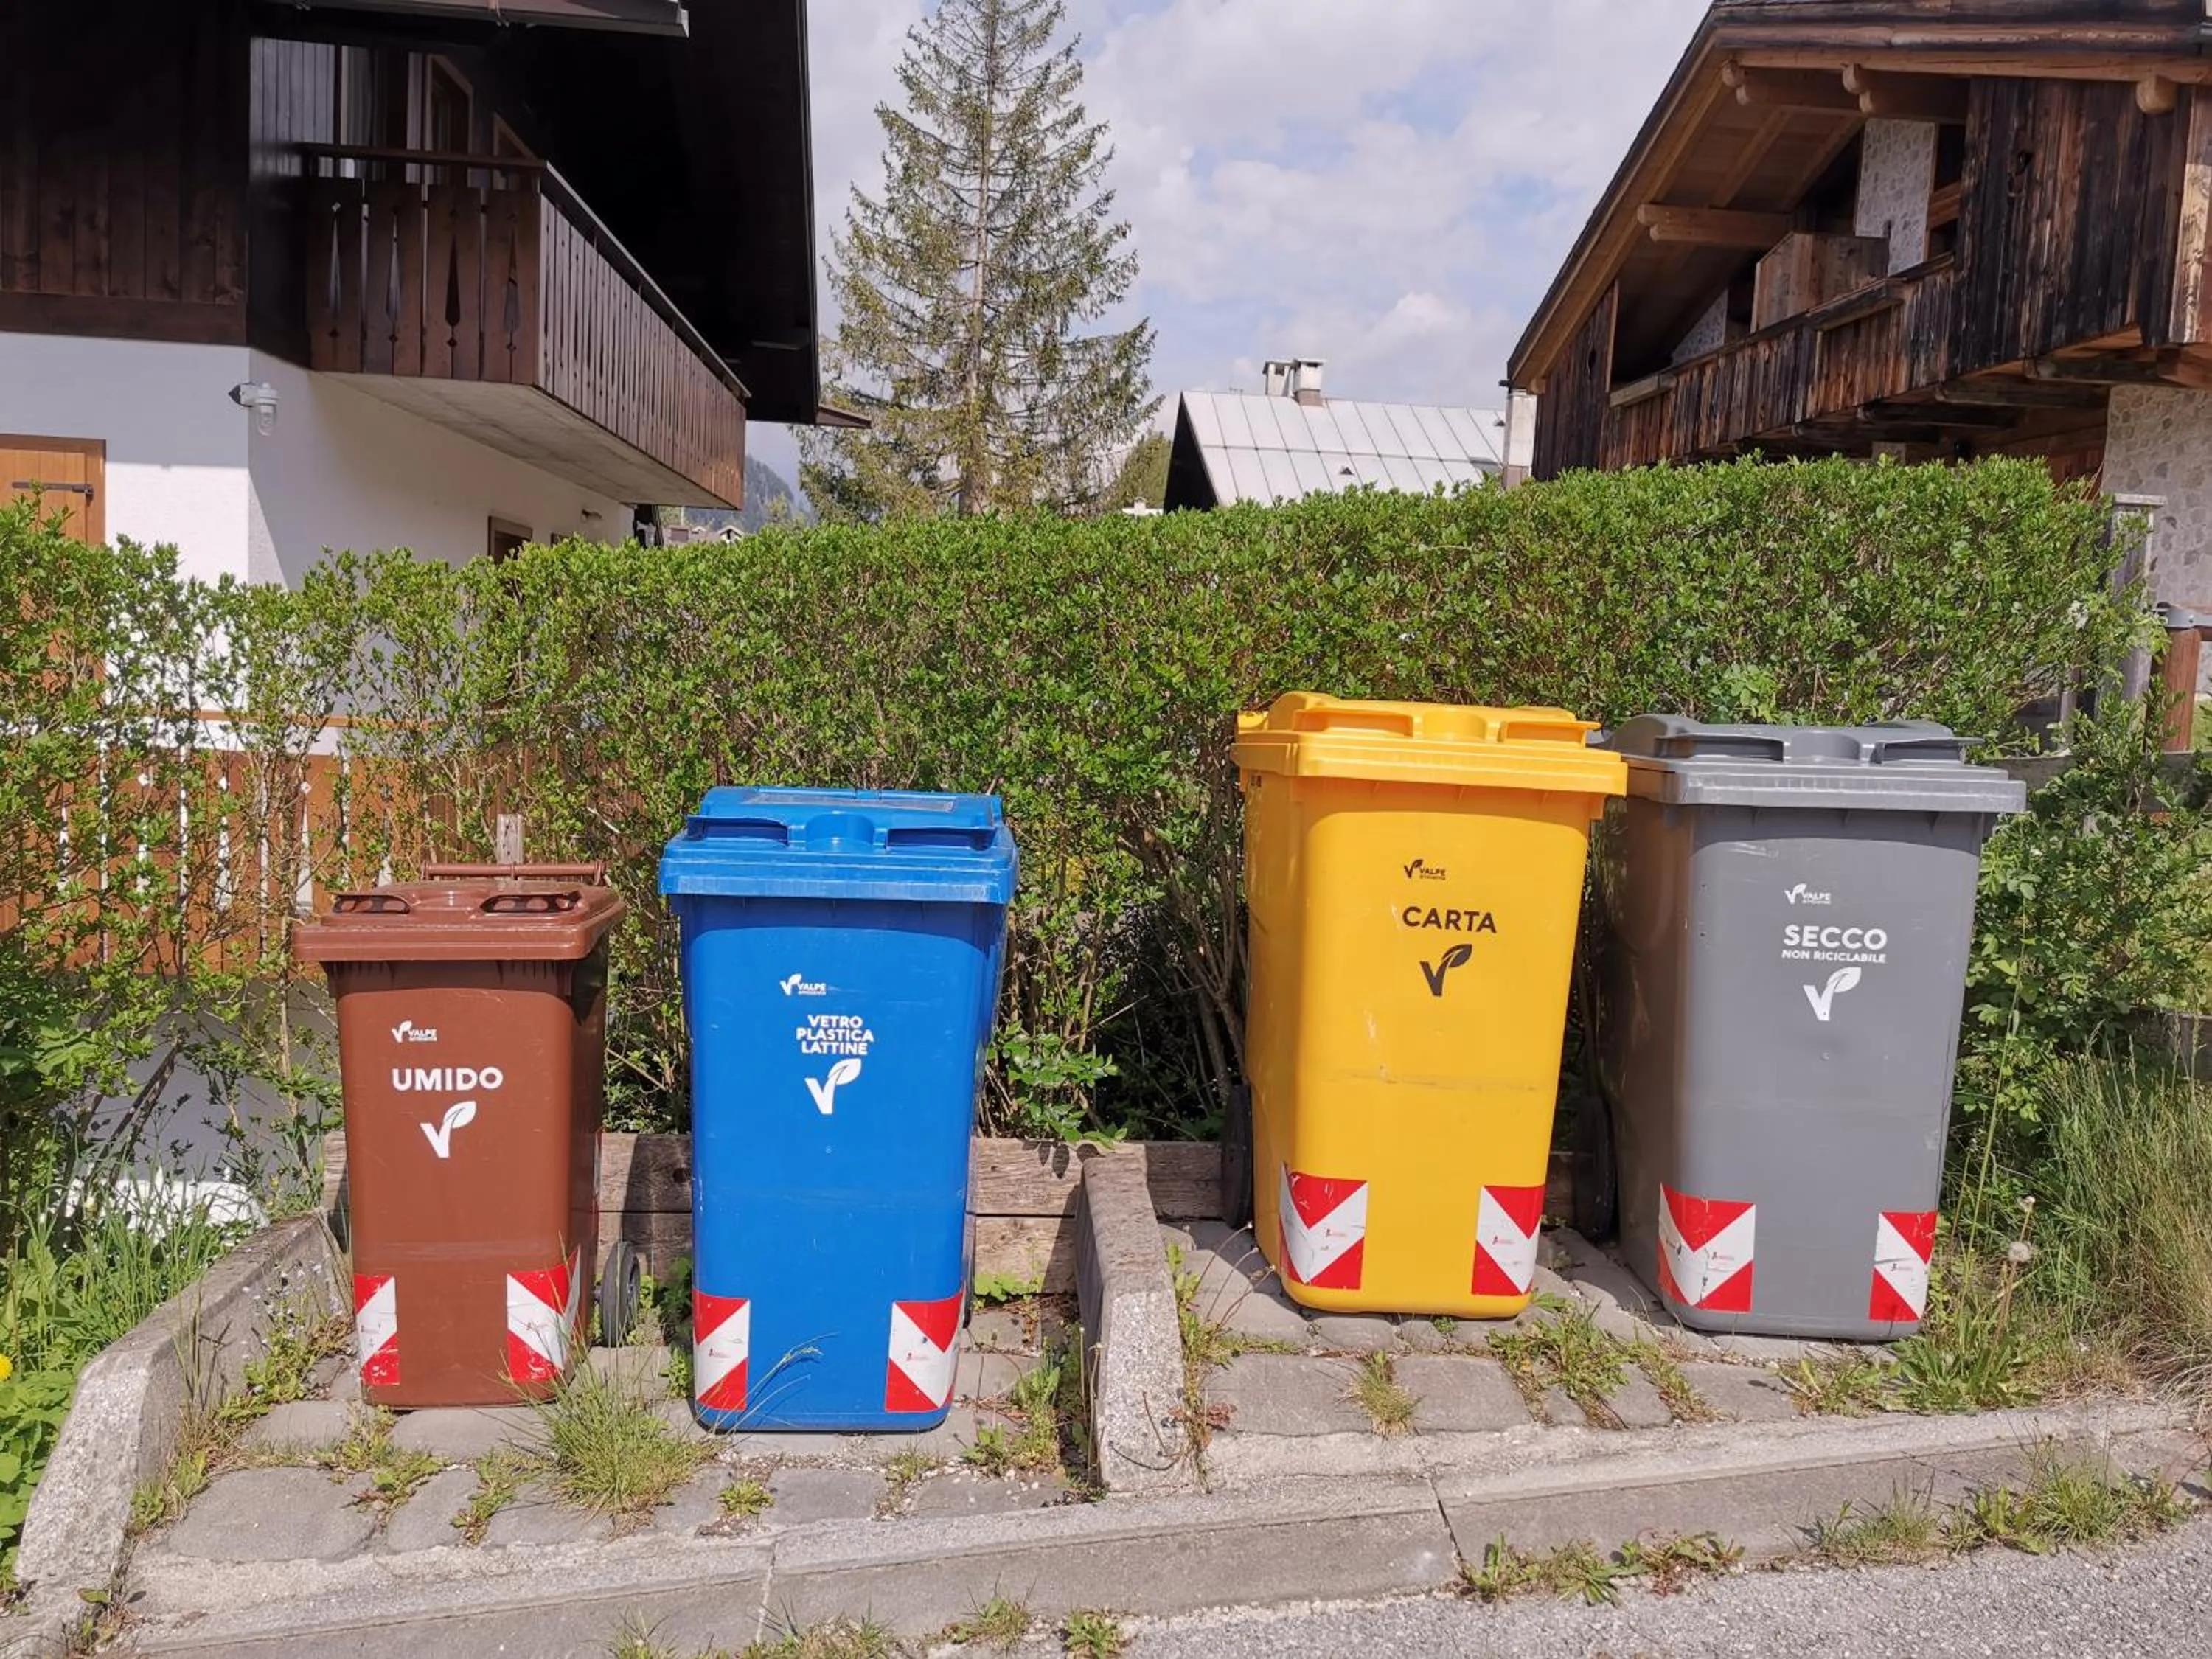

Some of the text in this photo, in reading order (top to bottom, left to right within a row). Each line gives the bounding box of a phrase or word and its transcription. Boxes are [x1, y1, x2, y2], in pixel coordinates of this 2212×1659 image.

[1402, 906, 1497, 933] CARTA
[1783, 924, 1888, 950] SECCO
[1781, 950, 1887, 964] NON RICICLABILE
[807, 1015, 863, 1029] VETRO
[796, 1027, 874, 1043] PLASTICA
[801, 1041, 868, 1055] LATTINE
[392, 1067, 504, 1091] UMIDO
